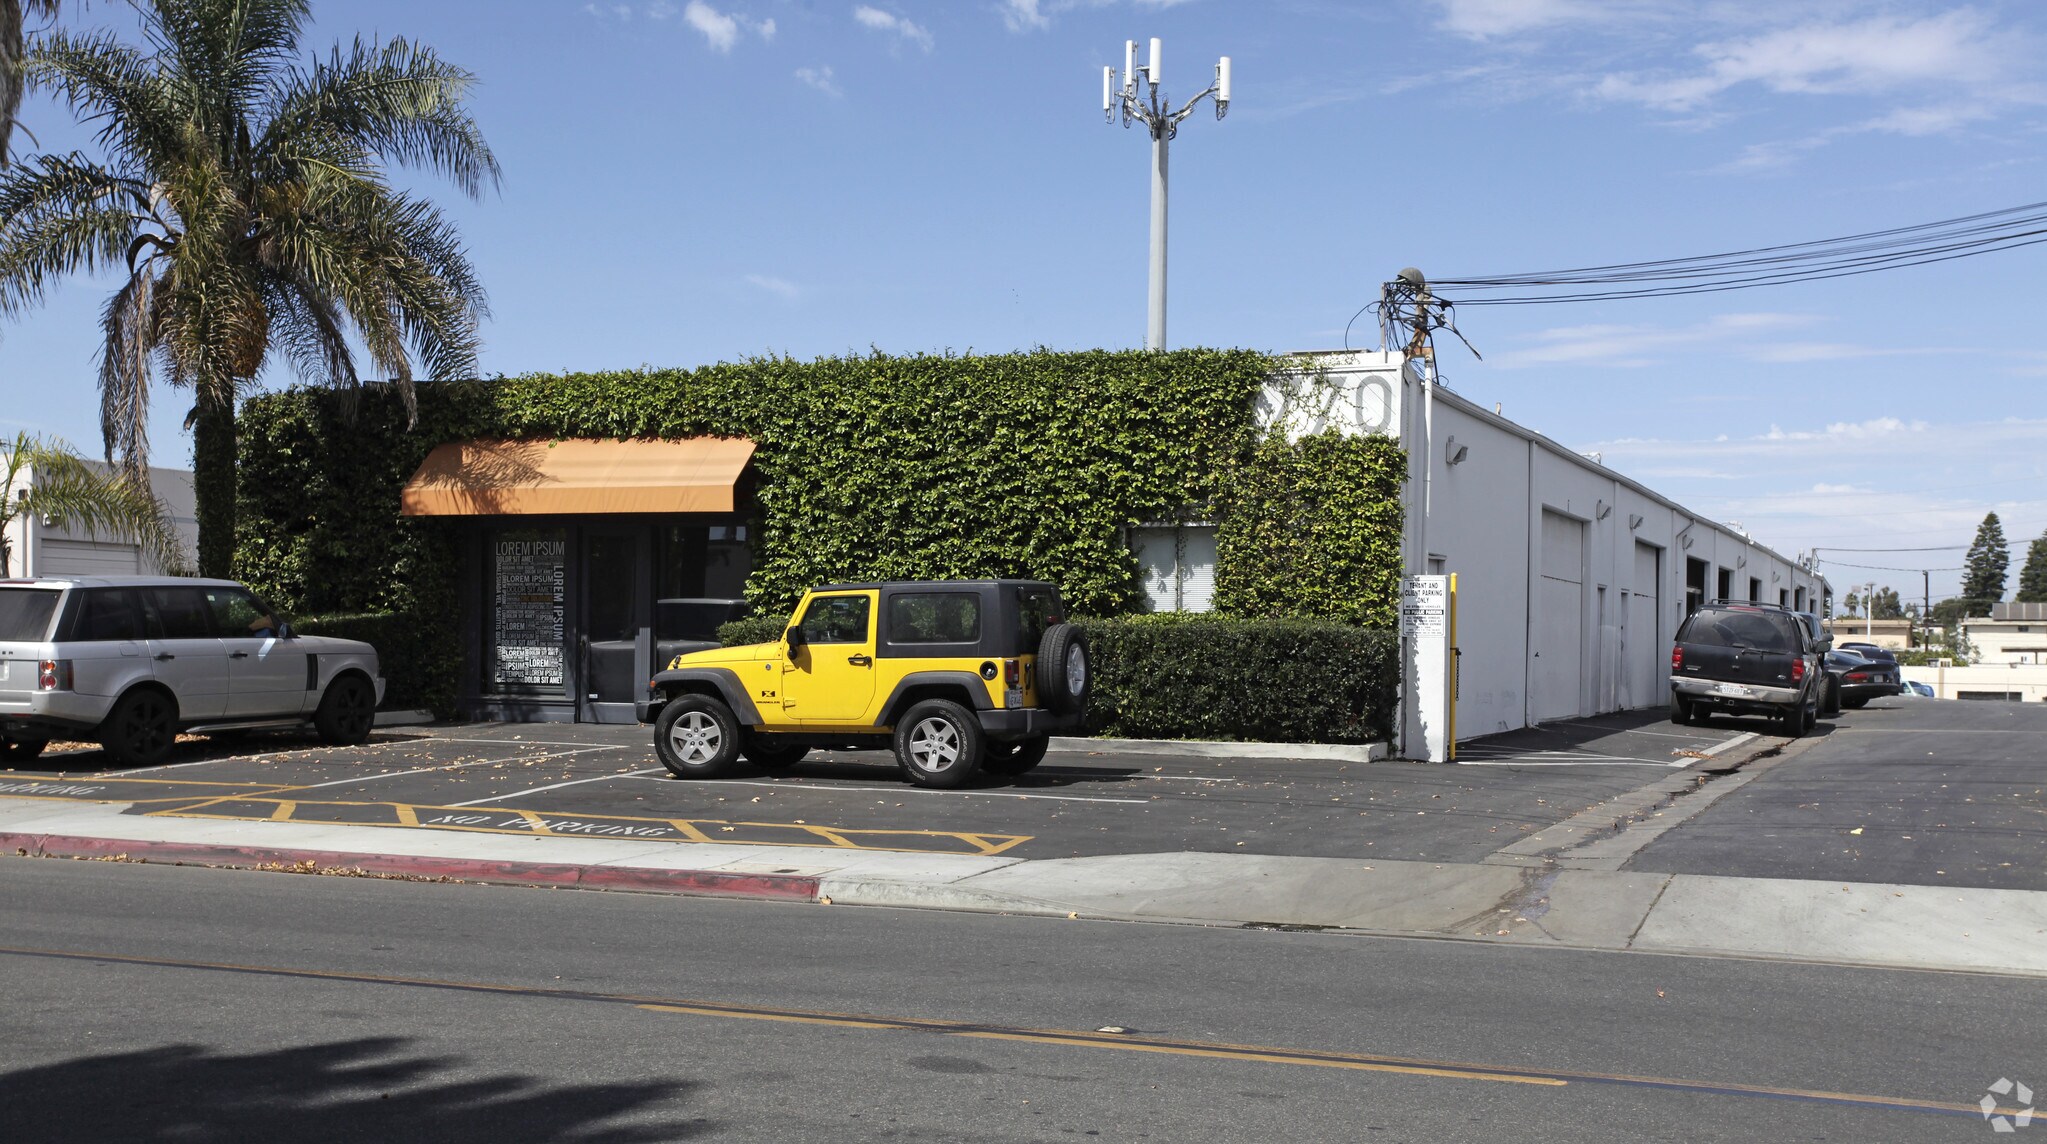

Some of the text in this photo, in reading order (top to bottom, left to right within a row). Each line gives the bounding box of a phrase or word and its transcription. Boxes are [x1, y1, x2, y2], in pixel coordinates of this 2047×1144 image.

[496, 541, 565, 556] LOREM IPSUM
[507, 575, 554, 583] LOREM IPSUM
[553, 565, 564, 641] LOREM IPSUM
[507, 622, 525, 631] LOREM
[502, 639, 517, 647] DOLOR
[518, 639, 526, 647] SIT
[527, 639, 540, 647] AMET
[506, 662, 525, 671] IPSUM
[529, 658, 549, 668] LOREM
[525, 676, 541, 684] DOLOR
[541, 676, 549, 684] SIT
[549, 676, 563, 684] AMET
[427, 815, 674, 837] NO PARKING
